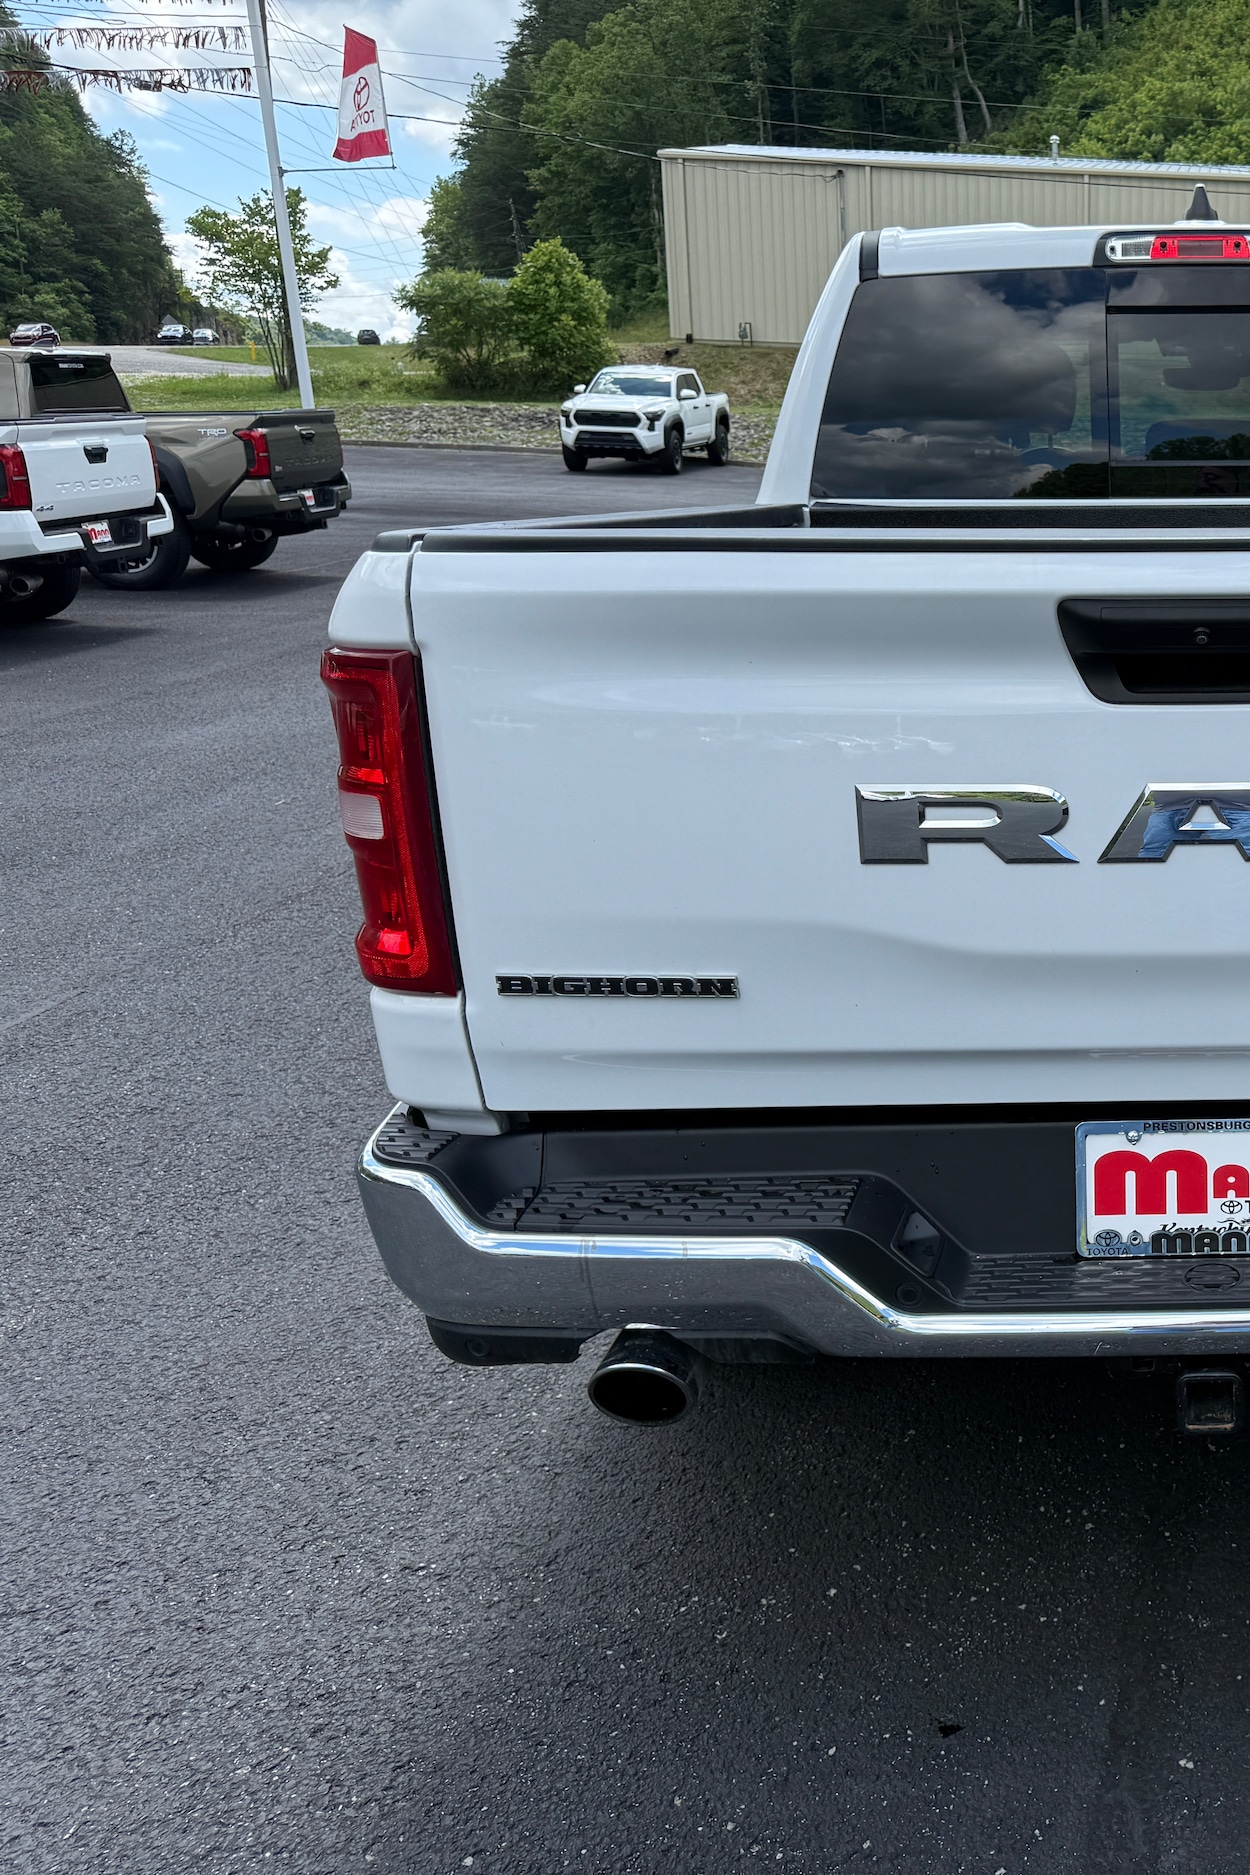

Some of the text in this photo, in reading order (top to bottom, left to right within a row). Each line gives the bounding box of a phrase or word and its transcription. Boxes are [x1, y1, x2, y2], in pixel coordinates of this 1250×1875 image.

[197, 428, 227, 437] TRD
[56, 475, 141, 493] TACOMA
[495, 973, 740, 998] BIGHORN
[1087, 1247, 1130, 1256] TOYOTA
